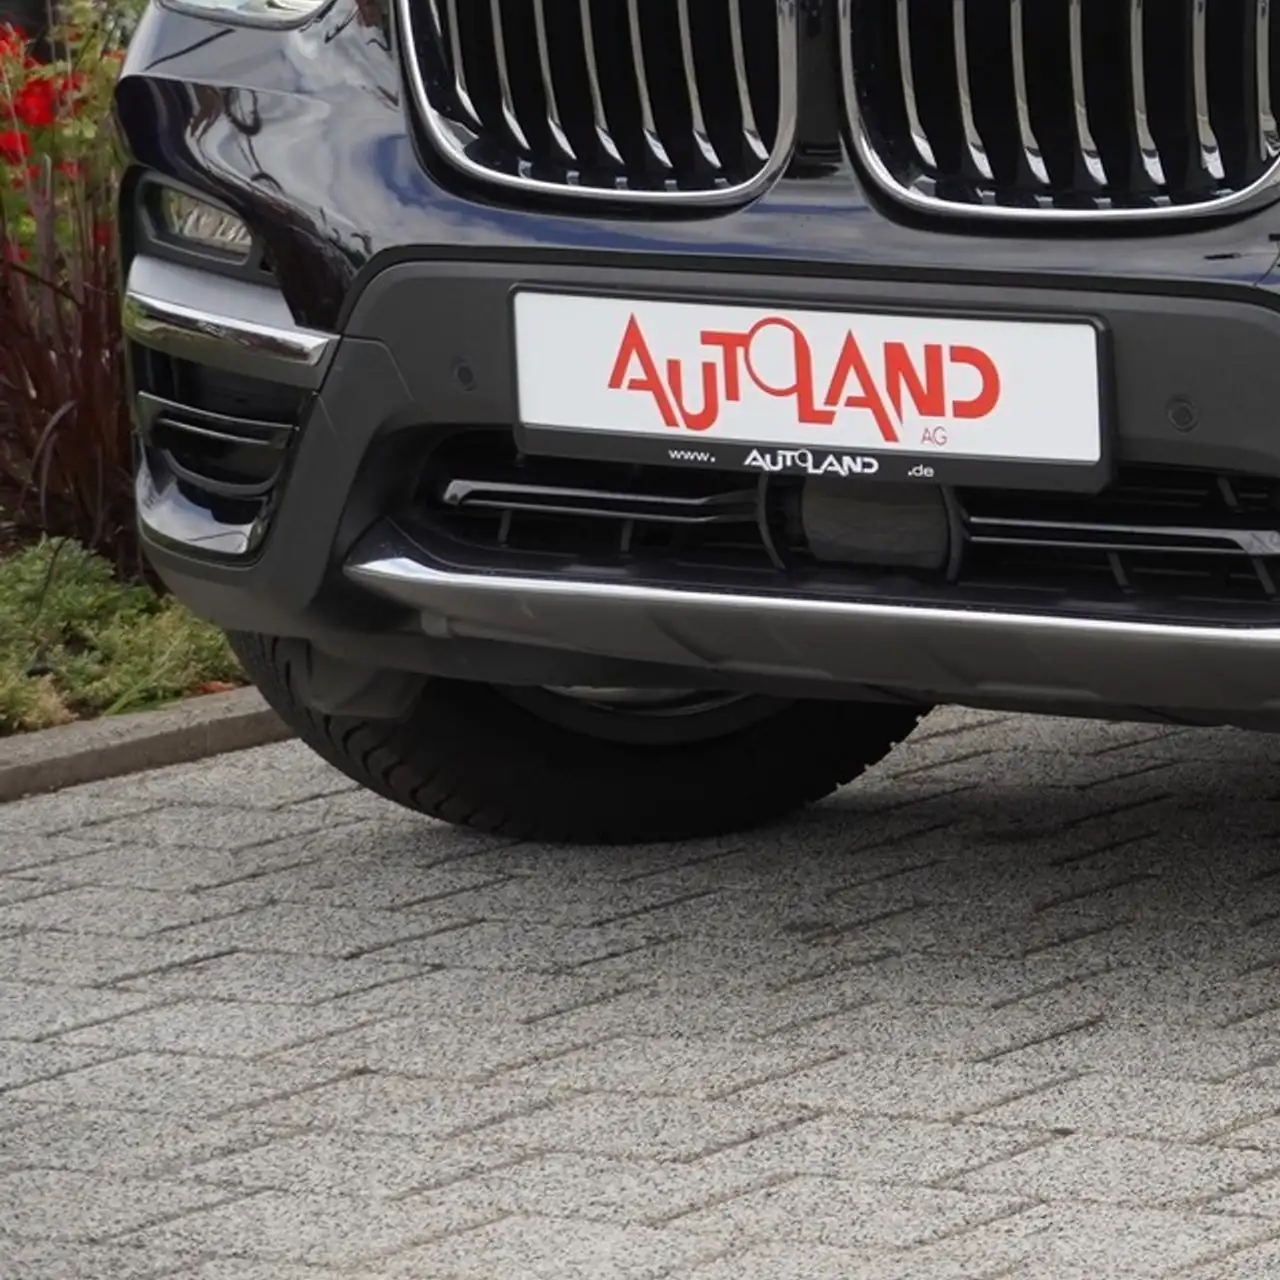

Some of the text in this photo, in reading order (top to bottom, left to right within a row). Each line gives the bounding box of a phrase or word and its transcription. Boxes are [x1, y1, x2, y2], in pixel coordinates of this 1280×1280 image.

[608, 312, 1001, 443] AUTOLAND
[921, 426, 947, 446] AG
[668, 449, 716, 464] www.
[907, 463, 935, 478] .de
